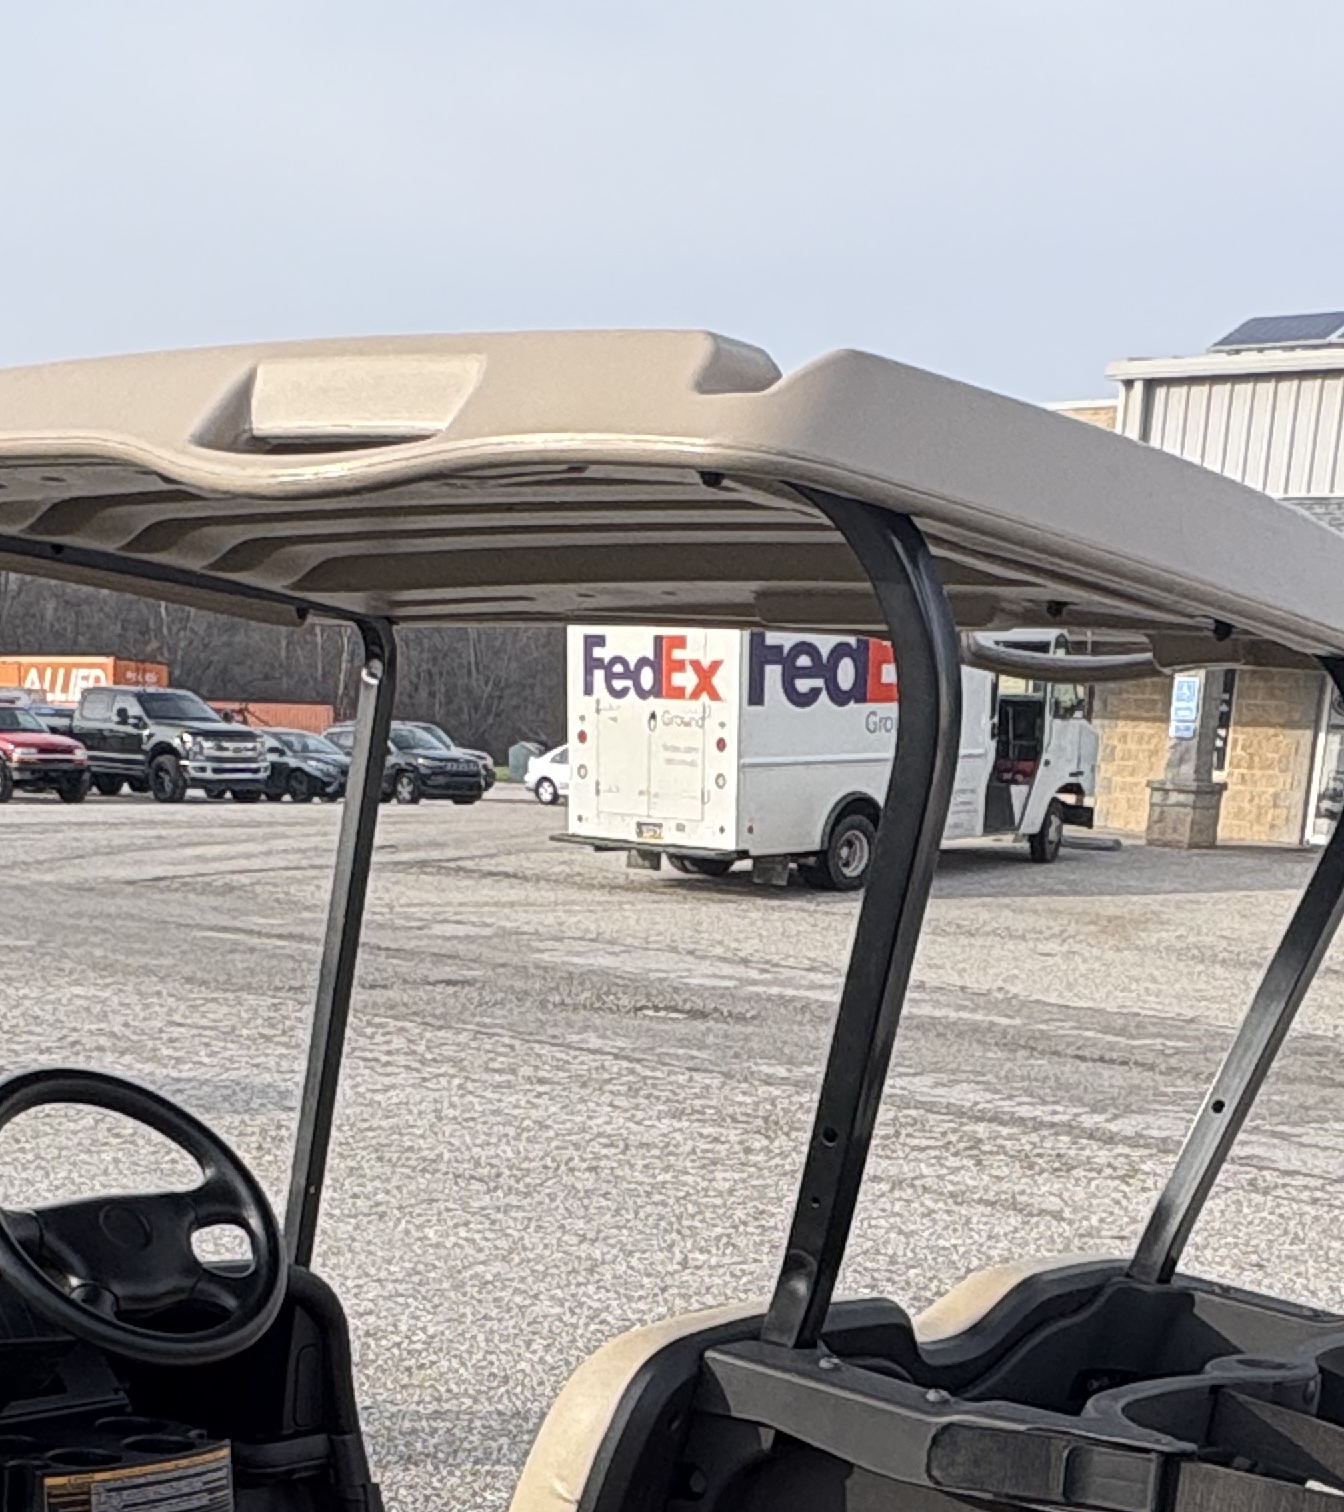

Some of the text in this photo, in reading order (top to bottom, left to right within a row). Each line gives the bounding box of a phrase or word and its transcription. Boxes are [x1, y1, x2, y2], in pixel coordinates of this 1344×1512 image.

[23, 666, 108, 702] ALLIED
[583, 634, 724, 701] FedEx
[747, 632, 899, 708] FedE
